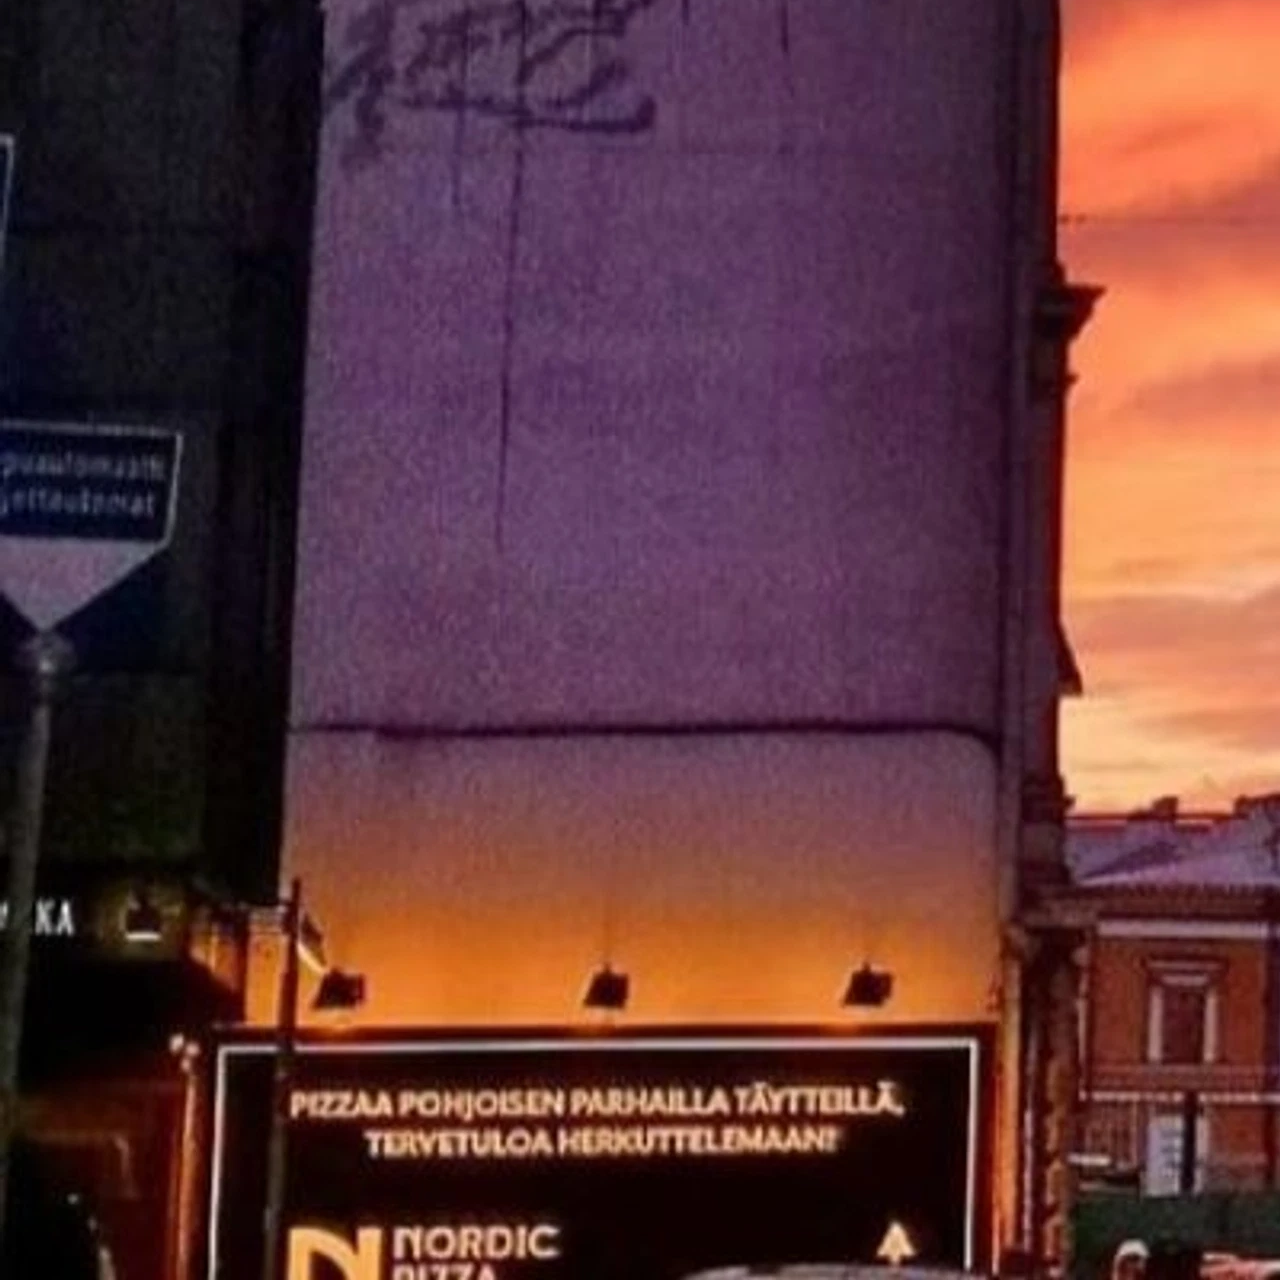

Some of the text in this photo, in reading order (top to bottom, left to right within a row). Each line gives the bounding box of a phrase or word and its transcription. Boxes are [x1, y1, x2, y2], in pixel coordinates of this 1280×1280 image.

[290, 1091, 393, 1119] PIZZAA
[398, 1089, 564, 1121] POHJOISEN
[364, 1129, 553, 1157] TERVETULOA
[393, 1225, 560, 1259] NORDIC
